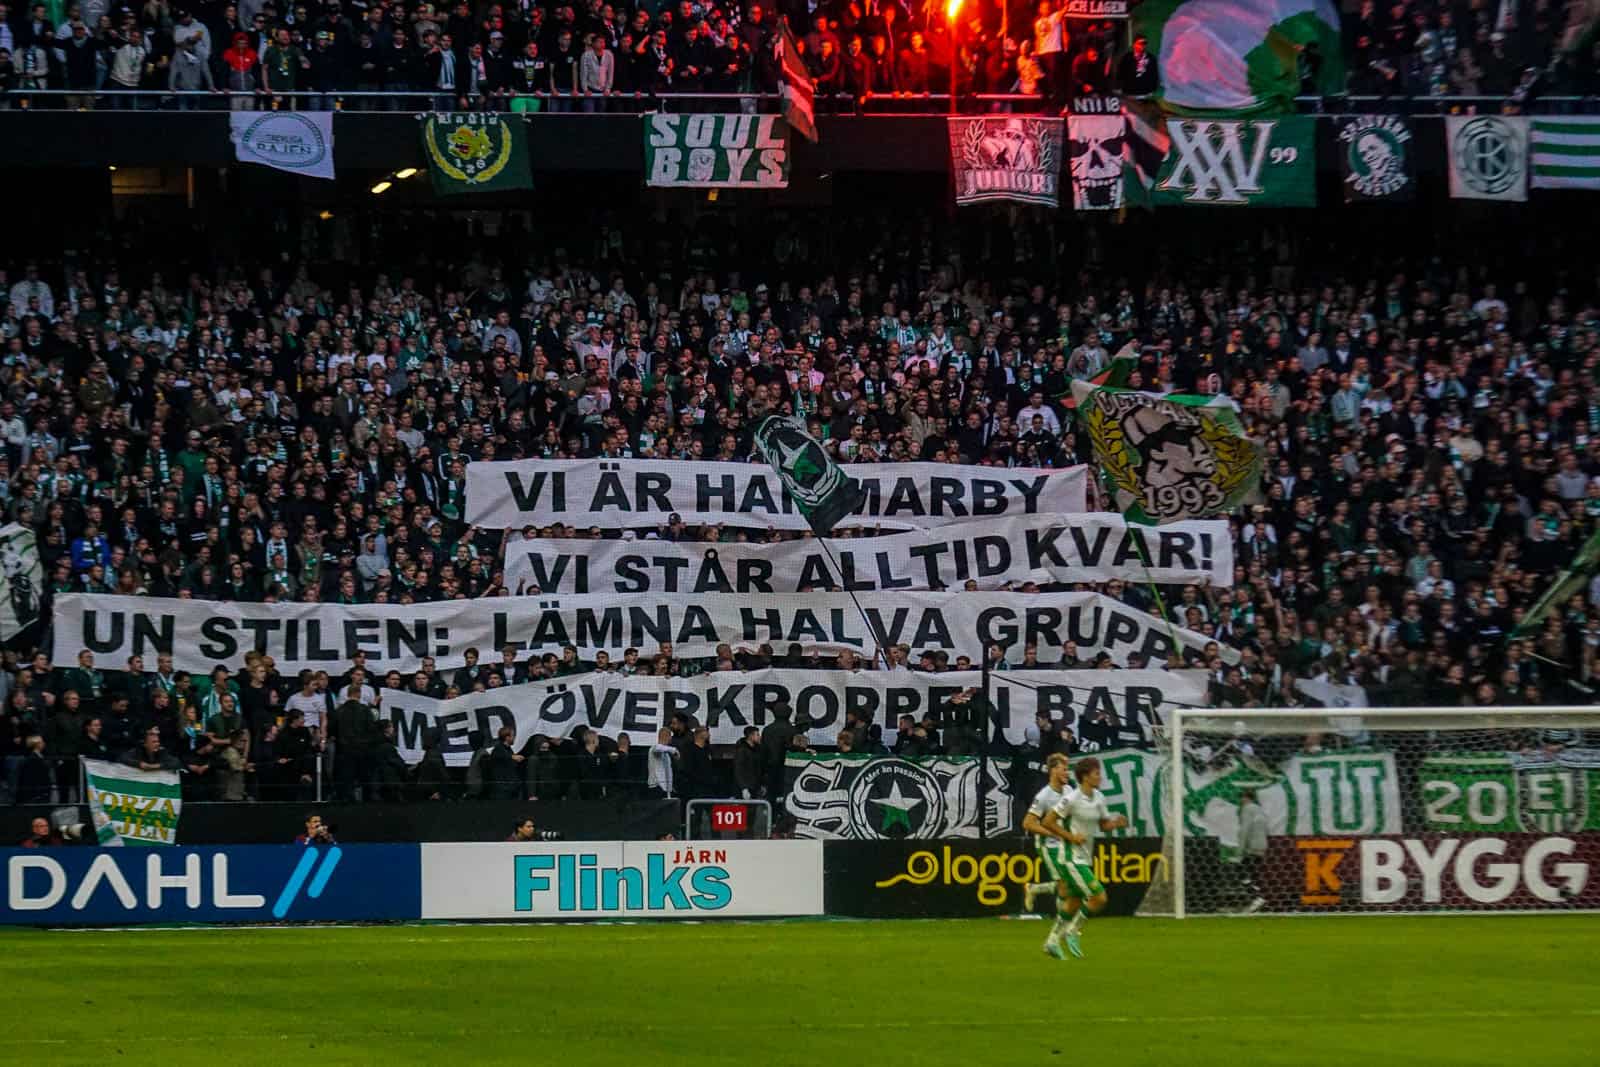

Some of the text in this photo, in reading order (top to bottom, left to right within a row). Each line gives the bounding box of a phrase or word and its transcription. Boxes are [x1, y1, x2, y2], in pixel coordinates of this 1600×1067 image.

[650, 113, 785, 149] SOUL
[651, 148, 786, 183] BOYS
[504, 462, 1050, 516] VI ÄR HAMARBY
[1143, 479, 1225, 516] 1993
[528, 525, 1214, 594] VI STÅR ALLTID KVAR!
[82, 610, 175, 656] UN
[200, 616, 450, 661] STILEN:
[493, 601, 721, 651] LÄMNA
[739, 607, 955, 650] HALVA
[390, 705, 517, 753] MED
[1036, 685, 1165, 728] BAR
[714, 811, 744, 826] 101
[1424, 779, 1508, 825] 20
[7, 852, 266, 911] DAHL
[513, 852, 733, 912] Flinks
[672, 847, 727, 865] JÄRN
[1360, 838, 1590, 904] BYGG
